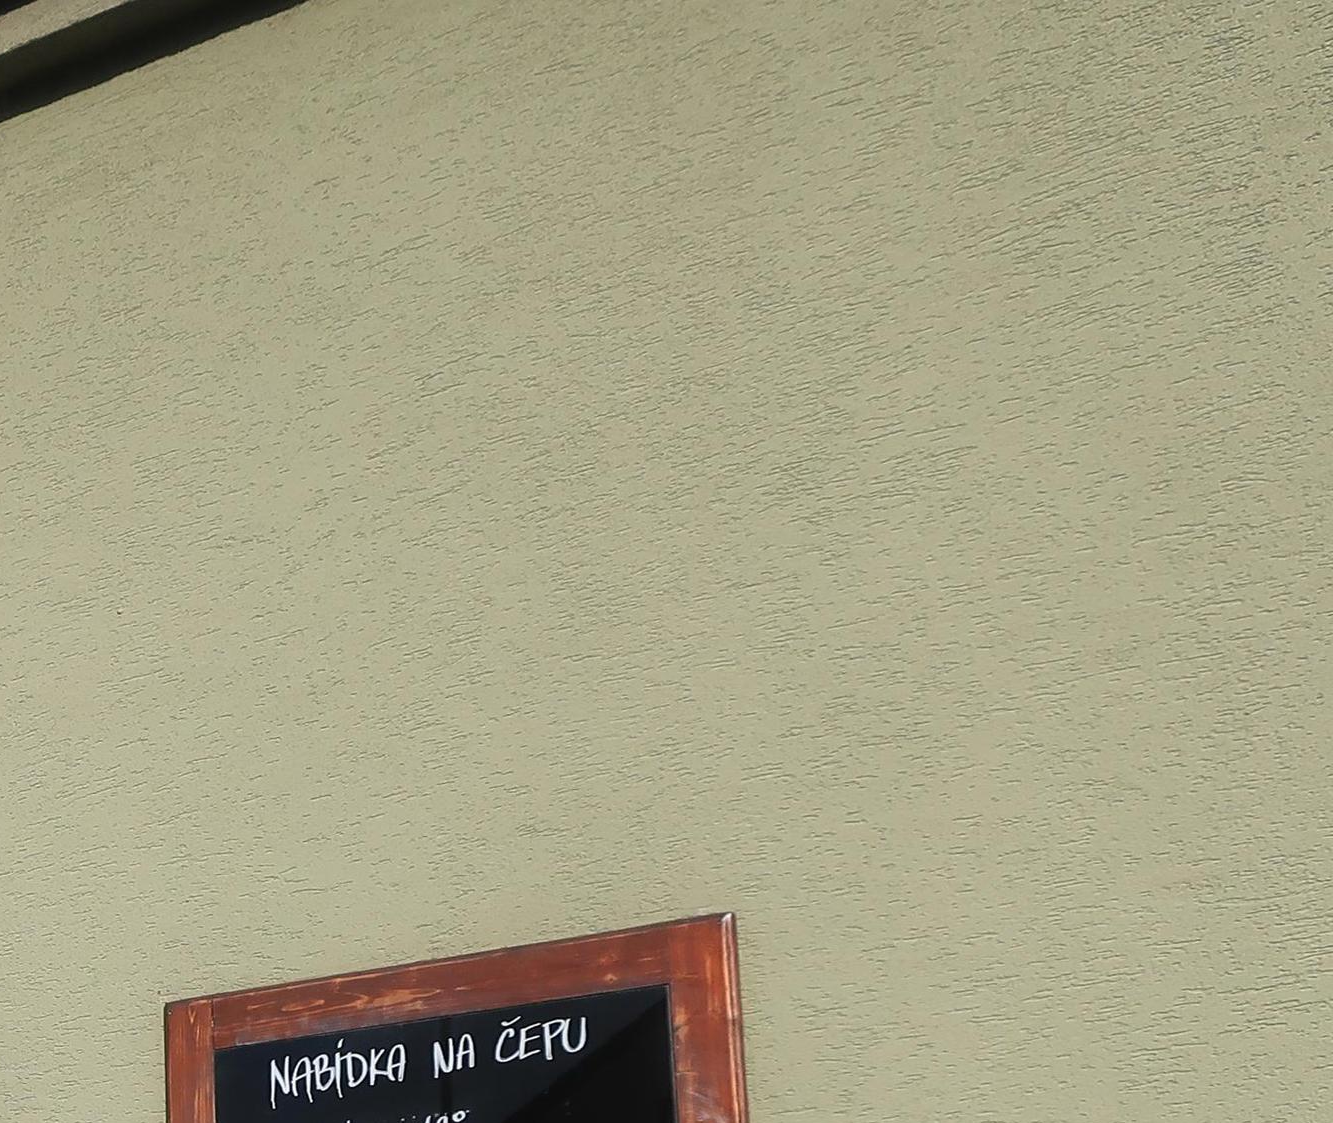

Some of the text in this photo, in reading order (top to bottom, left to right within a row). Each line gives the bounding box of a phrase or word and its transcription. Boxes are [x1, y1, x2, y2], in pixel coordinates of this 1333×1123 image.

[269, 1015, 588, 1111] NABÍDKA NA ČEPU
